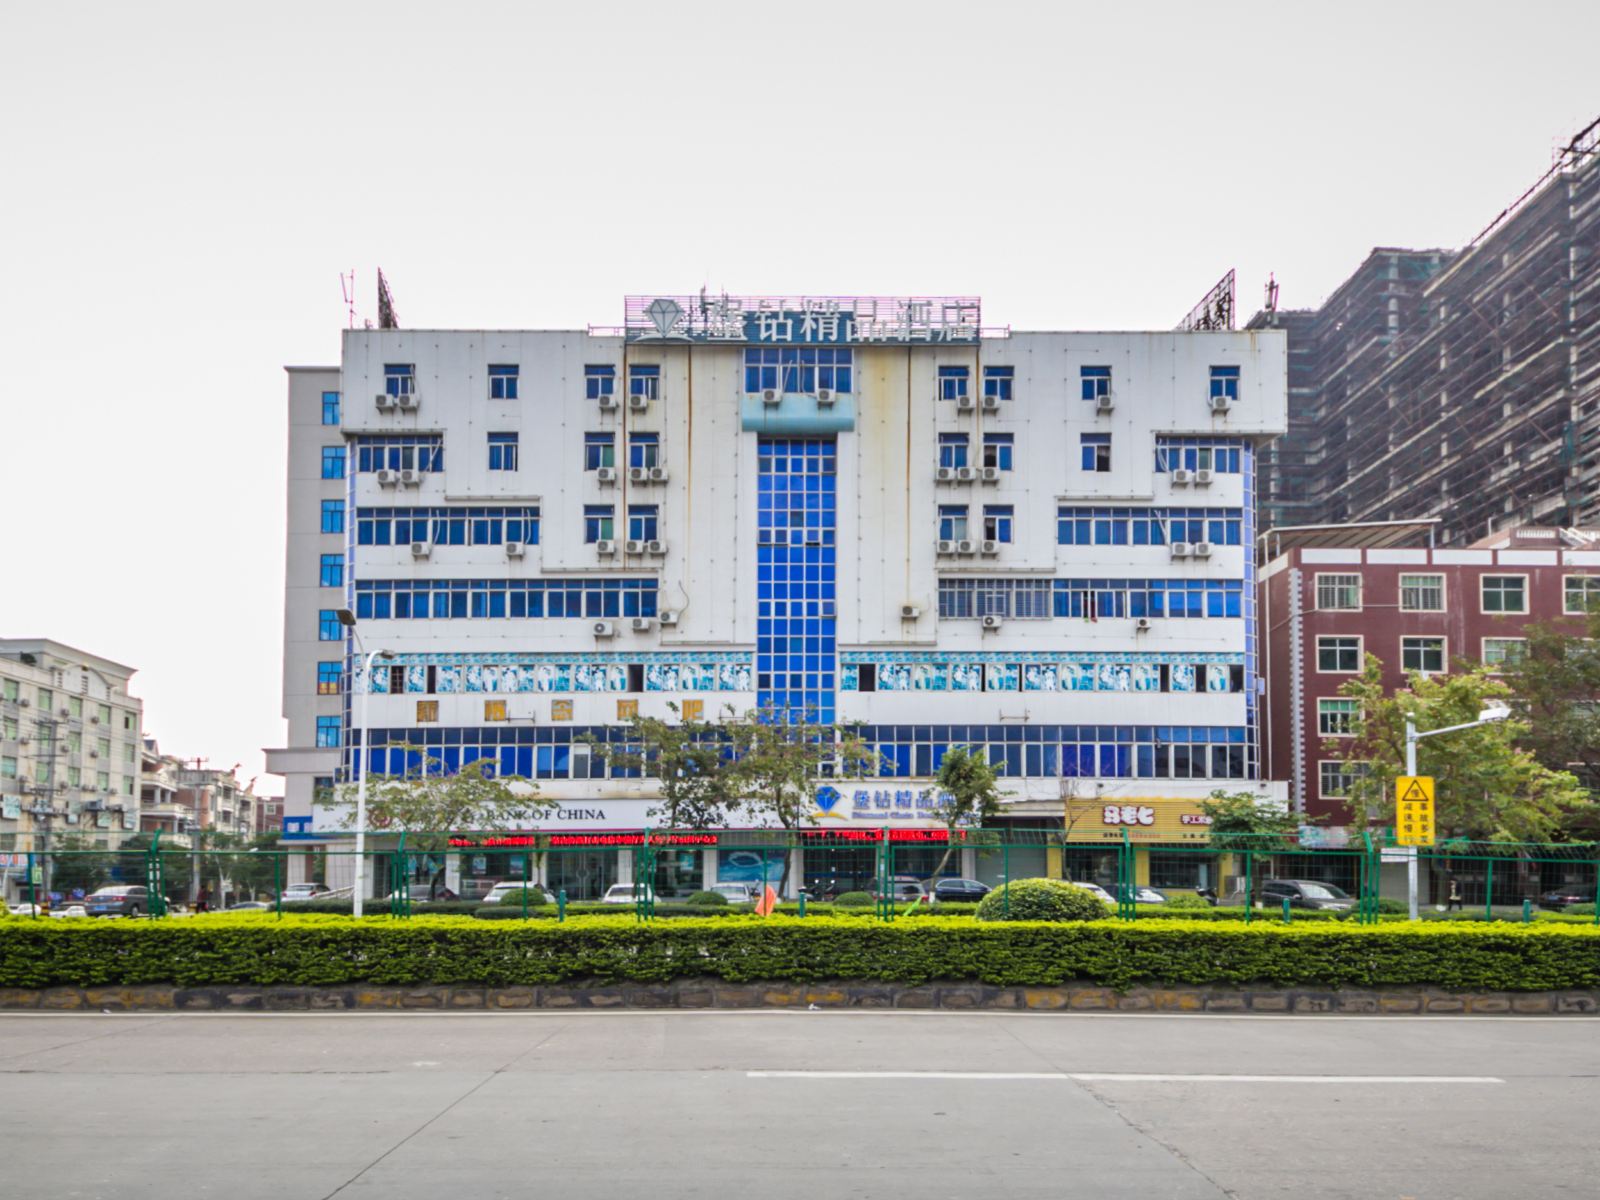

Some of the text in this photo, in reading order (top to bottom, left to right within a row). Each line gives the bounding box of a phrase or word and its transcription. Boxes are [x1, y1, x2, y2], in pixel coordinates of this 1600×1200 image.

[852, 789, 974, 810] 堡钻精品酒
[532, 809, 552, 820] OF
[557, 809, 606, 820] CHINA
